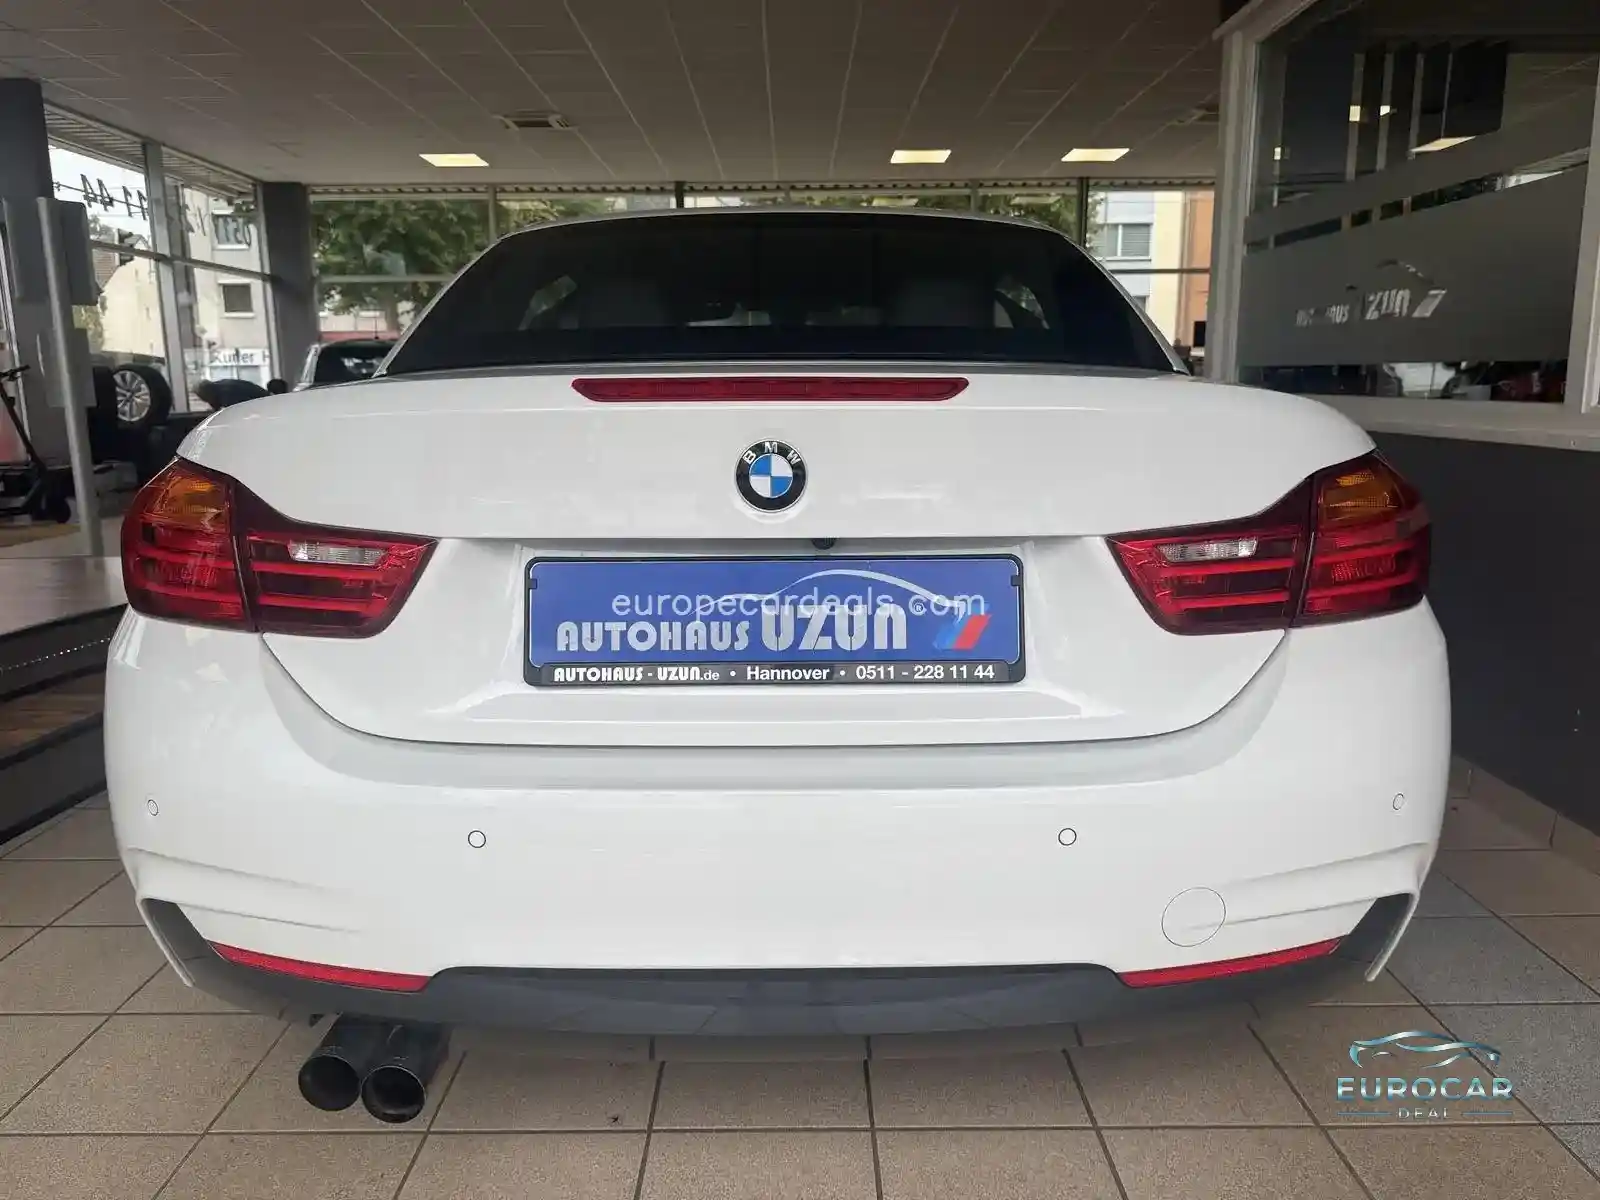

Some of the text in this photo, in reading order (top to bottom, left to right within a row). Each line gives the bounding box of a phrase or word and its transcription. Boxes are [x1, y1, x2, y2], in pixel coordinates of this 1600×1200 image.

[742, 441, 802, 465] BMW
[556, 603, 908, 652] AUTOHAUS UZUN
[553, 666, 644, 682] AUTOHAUS
[746, 665, 830, 681] Hannover
[855, 665, 896, 680] 0511
[913, 664, 945, 679] 228
[949, 664, 968, 679] 11
[973, 664, 995, 679] 44
